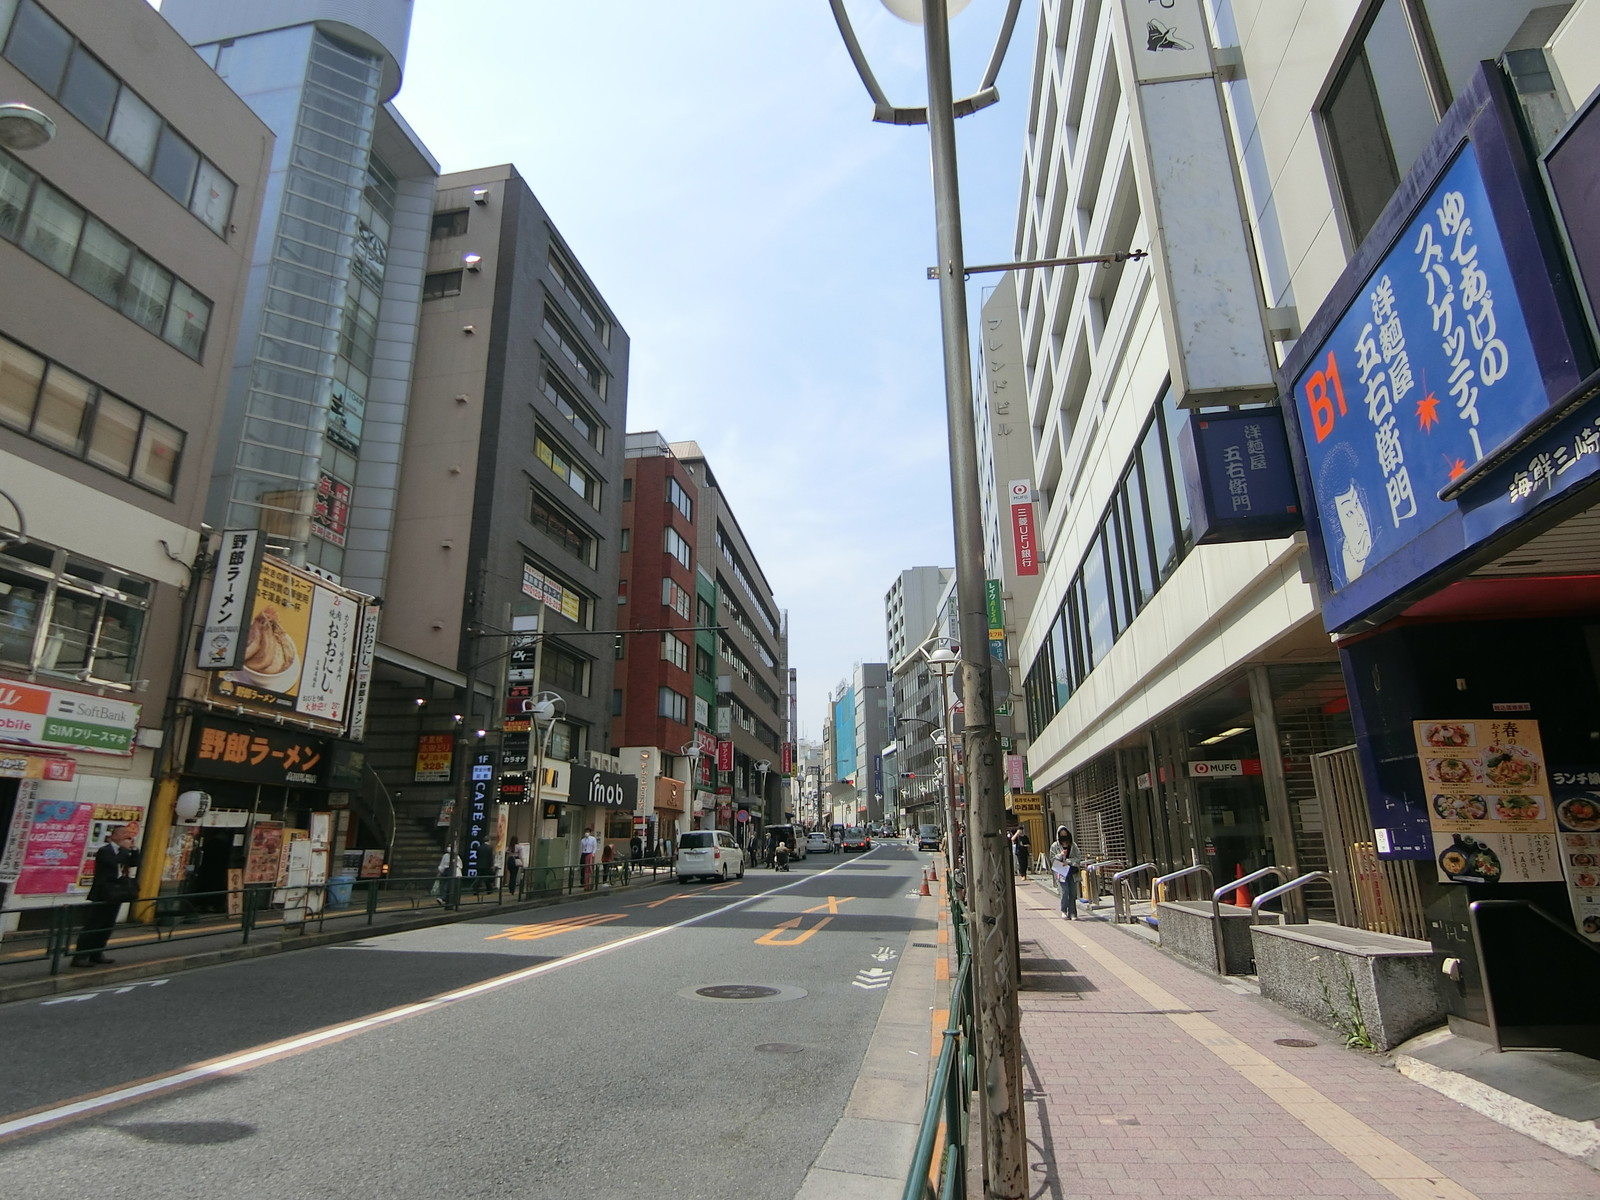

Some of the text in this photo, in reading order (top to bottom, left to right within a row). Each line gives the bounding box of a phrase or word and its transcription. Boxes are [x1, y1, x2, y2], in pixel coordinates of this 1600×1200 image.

[1437, 192, 1508, 386] ゆであげの
[1415, 223, 1485, 460] スパゲッティー
[988, 318, 1012, 436] フレンドビル
[1305, 350, 1347, 444] B1
[1354, 323, 1417, 529] 五右衛門
[1223, 445, 1252, 511] 五右衛門
[1509, 416, 1600, 504] 海鮮三崎
[1017, 508, 1032, 567] 三菱UFJ銀行
[217, 534, 248, 624] 野郎ラーメン
[321, 620, 339, 692] おおにし
[362, 622, 376, 668] おおにし
[77, 703, 127, 722] SoftBank
[235, 685, 276, 703] 野郎ラーメン
[354, 681, 368, 726] 野郎ラーメン
[49, 725, 127, 744] SIMフリースマホ
[199, 728, 321, 771] 野郎ラーメン
[1491, 723, 1503, 755] おすすめ
[1502, 722, 1519, 746] 春の
[478, 755, 489, 764] 1F
[504, 756, 526, 764] カラオケ
[1210, 763, 1237, 772] MUFG
[471, 825, 482, 837] de
